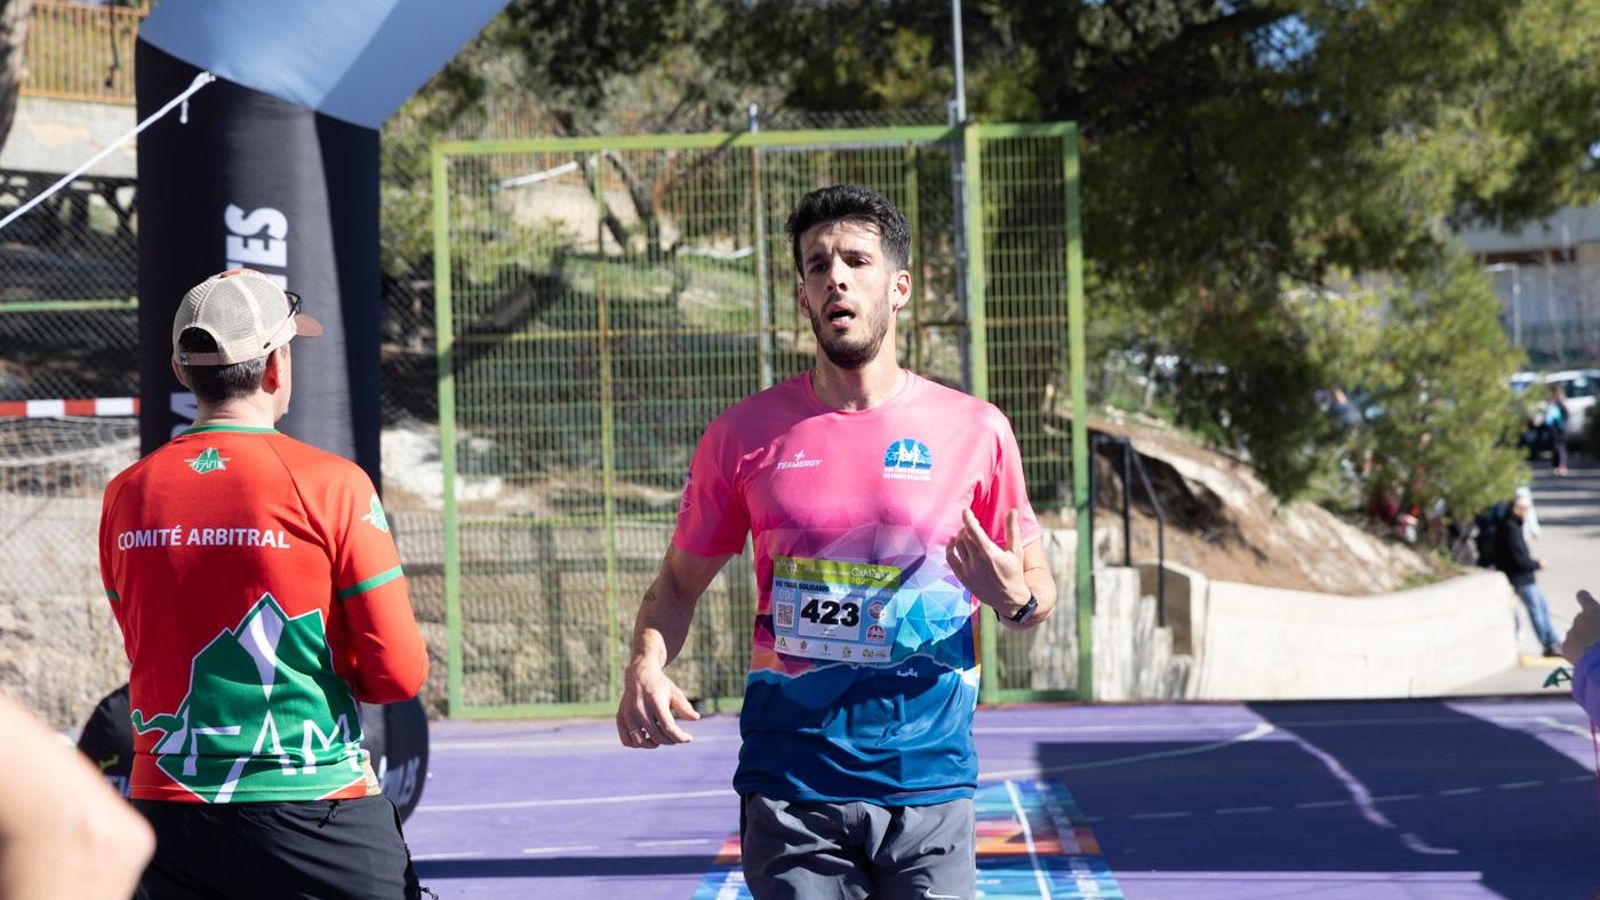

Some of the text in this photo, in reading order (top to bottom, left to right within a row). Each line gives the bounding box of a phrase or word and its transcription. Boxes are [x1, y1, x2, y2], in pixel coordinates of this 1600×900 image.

[118, 525, 290, 550] COMITÉ ARBITRAL
[800, 598, 859, 627] 423
